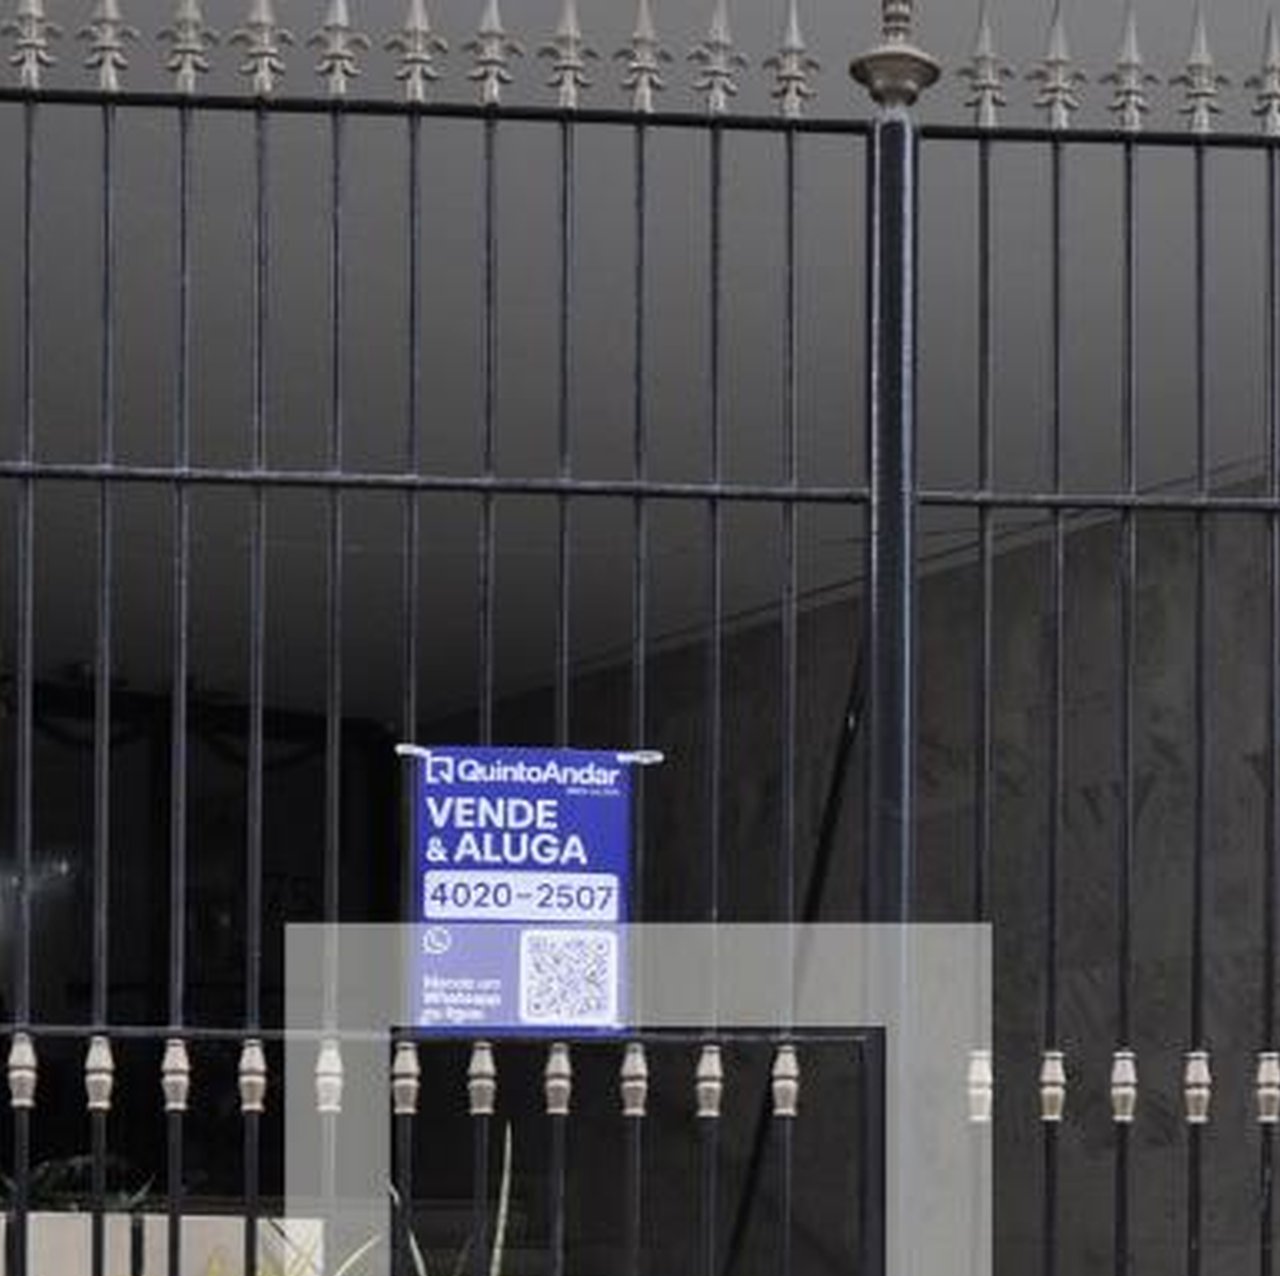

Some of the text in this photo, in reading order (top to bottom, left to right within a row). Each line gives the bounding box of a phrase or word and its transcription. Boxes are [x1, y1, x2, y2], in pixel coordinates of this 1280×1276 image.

[457, 759, 620, 785] QuintoAndar
[426, 797, 557, 829] VENDE
[426, 833, 587, 865] & ALUGA
[429, 883, 613, 910] 4020-2507
